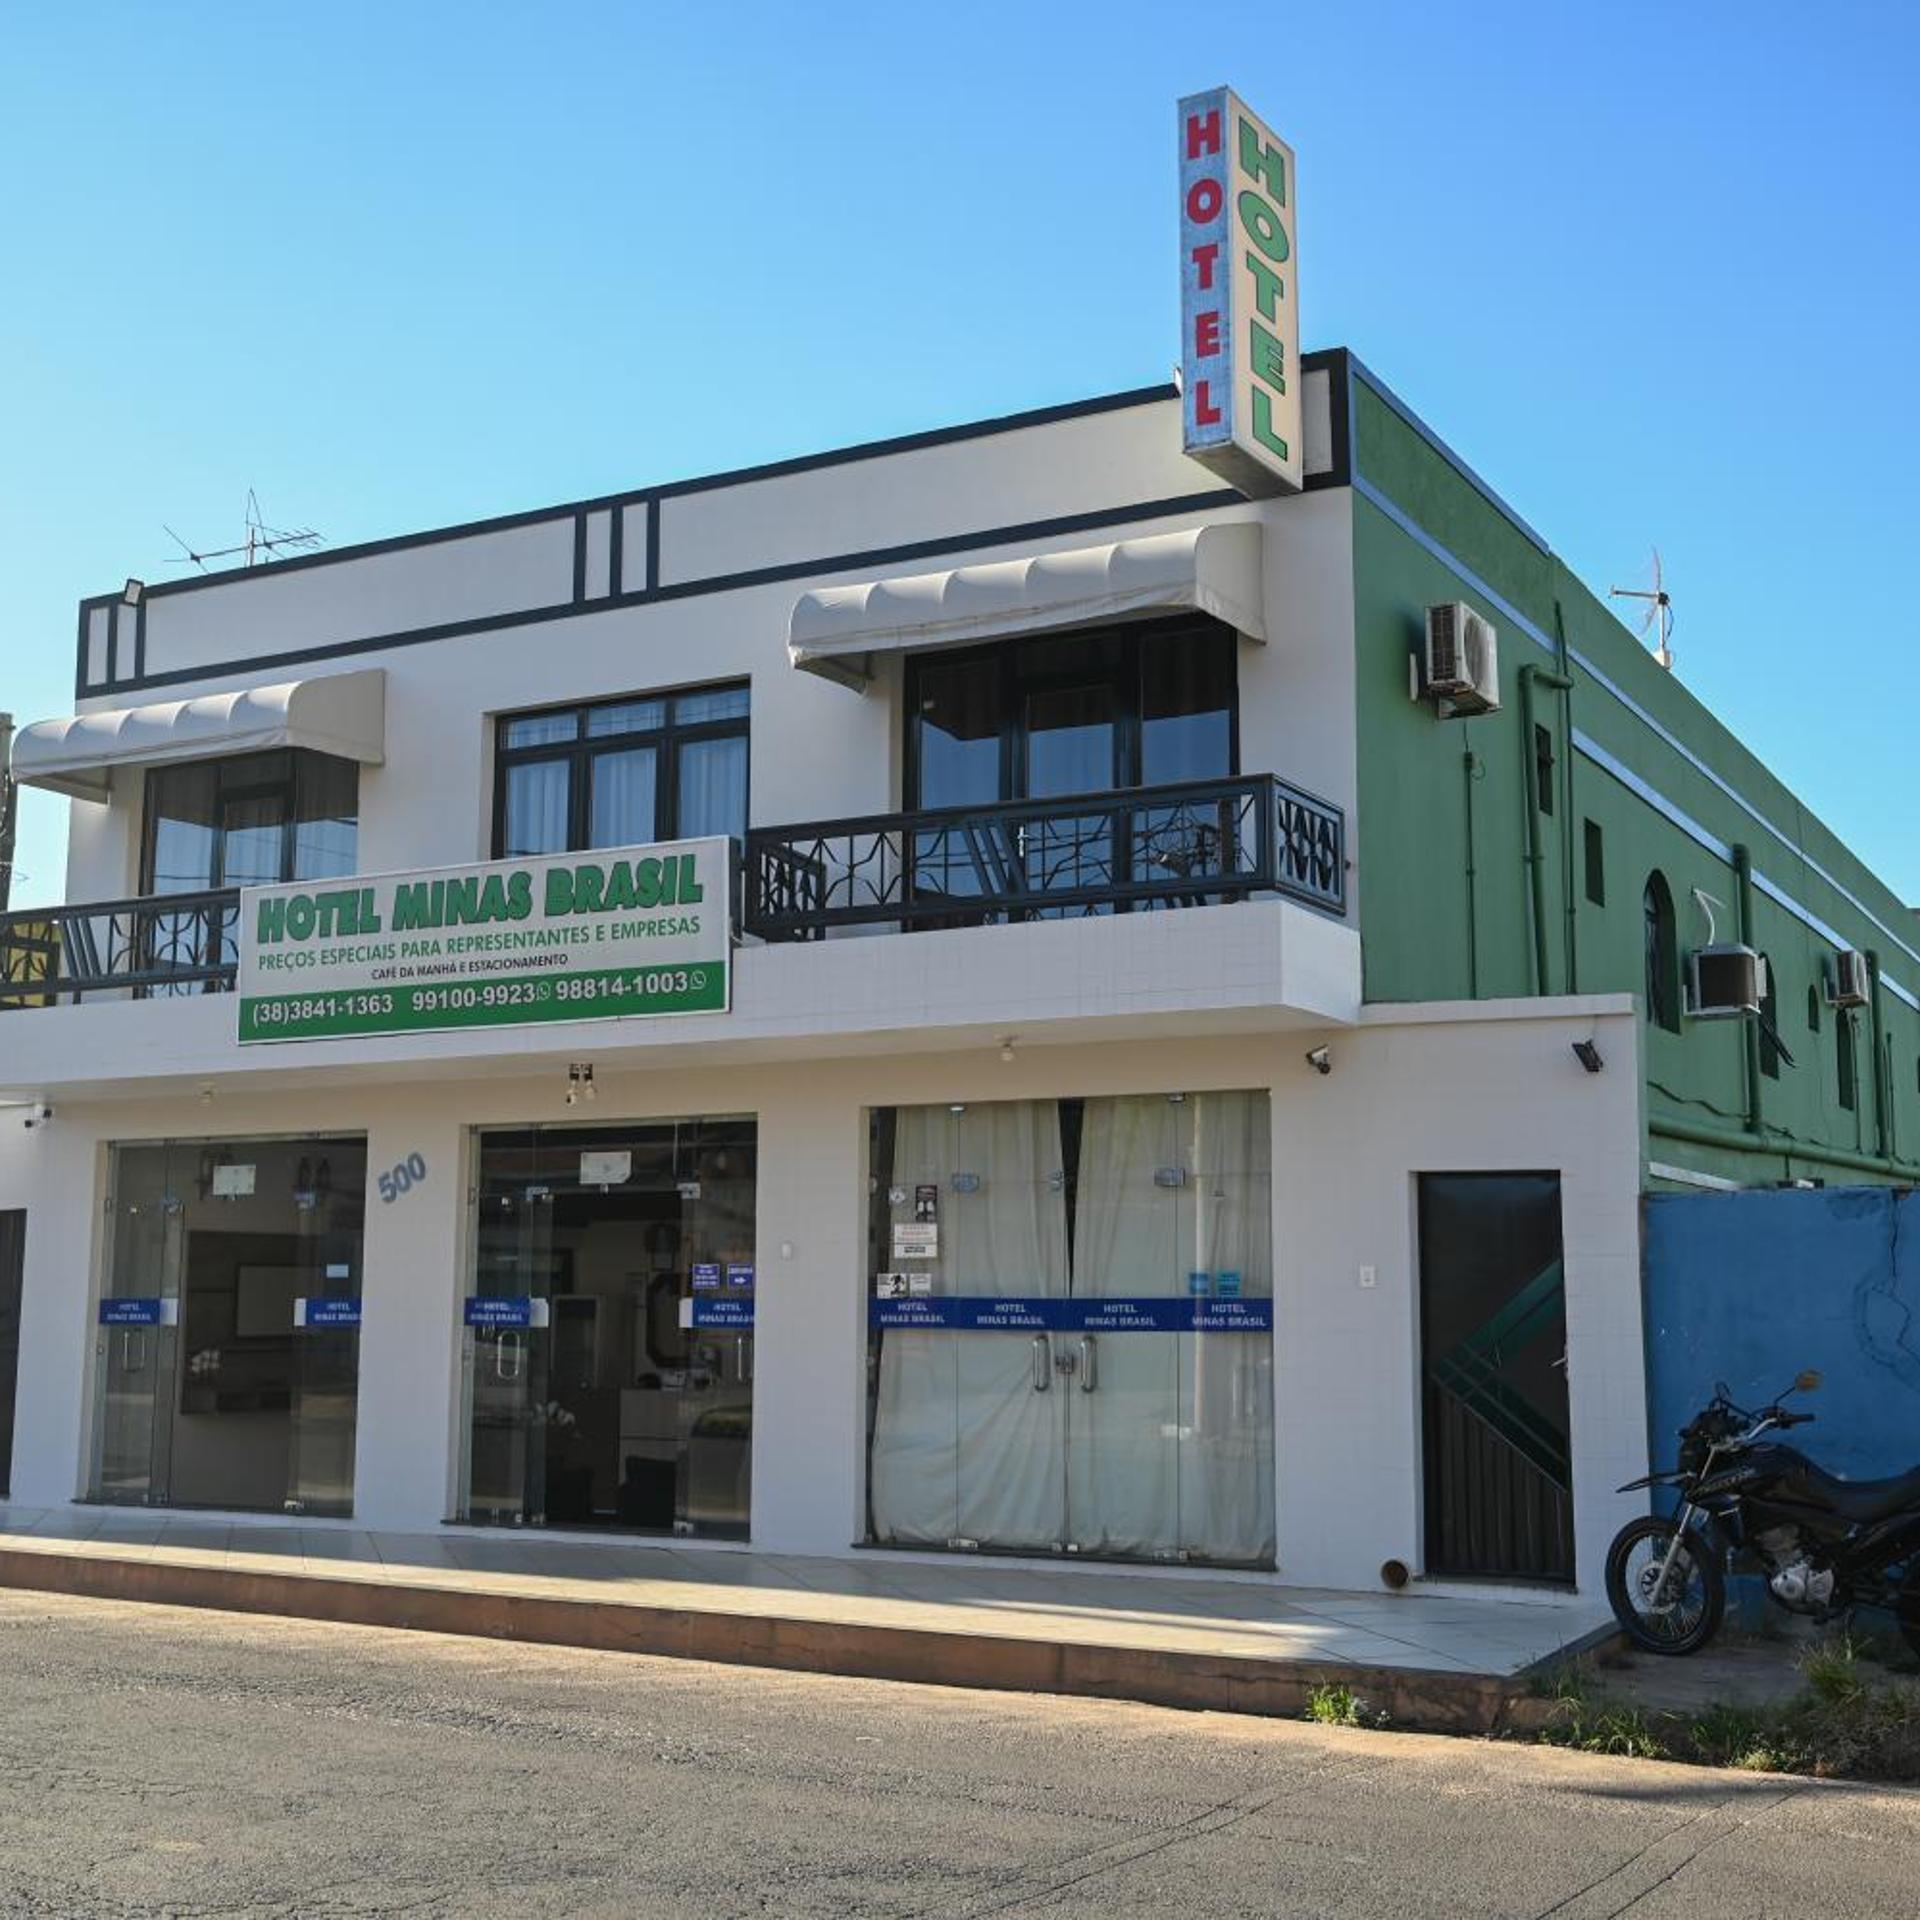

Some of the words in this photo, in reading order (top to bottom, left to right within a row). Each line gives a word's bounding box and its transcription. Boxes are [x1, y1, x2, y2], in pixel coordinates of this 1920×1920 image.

[1186, 110, 1223, 426] HOTEL
[1237, 114, 1290, 462] HOTEL
[258, 887, 381, 944] HOTEL
[392, 870, 533, 932] MINAS
[545, 854, 703, 917] BRASIL
[258, 951, 316, 972] PREÇOS
[320, 943, 396, 966] ESPECIAIS
[401, 939, 441, 958] PARA
[447, 926, 590, 954] REPRESENTANTES
[596, 924, 605, 942] E
[611, 916, 700, 940] EMPRESAS
[399, 966, 415, 978] DA
[459, 961, 466, 973] E
[468, 953, 569, 972] ESTACIONAMENTO
[253, 994, 394, 1026] (38)3841-1363
[412, 982, 535, 1011] 99100-9923
[555, 971, 688, 1000] 98814-1003
[378, 1152, 426, 1204] 500
[897, 1302, 929, 1312] HOTEL
[994, 1303, 1026, 1313] HOTEL
[1103, 1303, 1138, 1314] HOTEL
[1211, 1303, 1247, 1314] HOTEL
[976, 1315, 1008, 1325] MINAS
[1009, 1315, 1045, 1325] BRASIL
[1084, 1316, 1117, 1326] MINAS
[1118, 1316, 1157, 1326] BRASIL
[1191, 1316, 1226, 1327] MINAS
[1227, 1316, 1267, 1327] BRASIL
